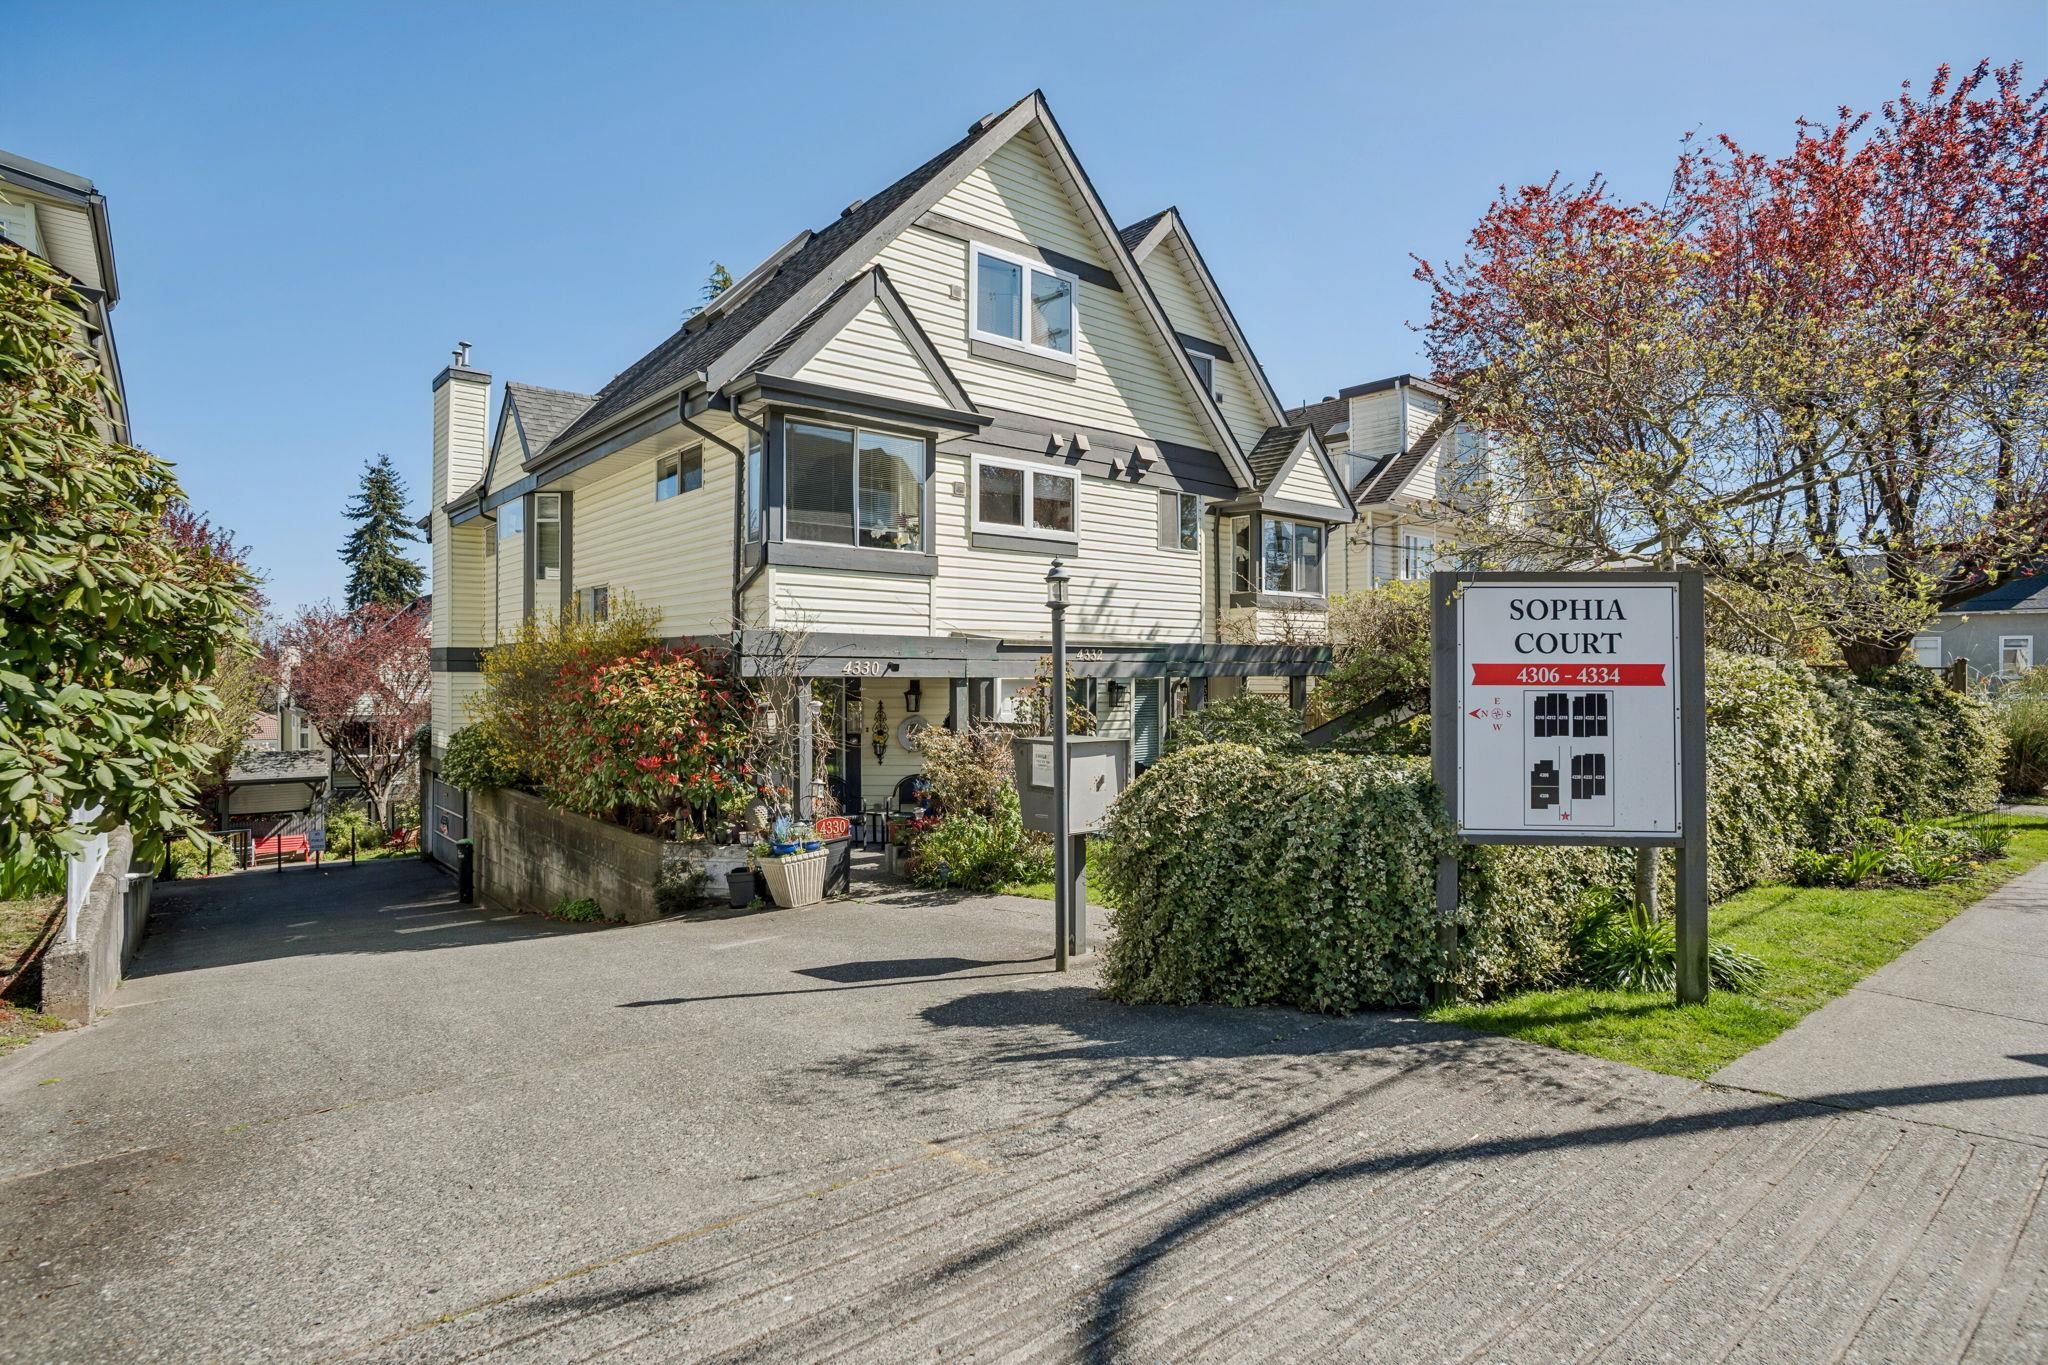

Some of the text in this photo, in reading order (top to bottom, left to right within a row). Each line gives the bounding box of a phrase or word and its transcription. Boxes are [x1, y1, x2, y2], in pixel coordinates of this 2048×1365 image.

[1509, 598, 1627, 621] SOPHIA
[1514, 632, 1622, 654] COURT
[1076, 649, 1103, 661] 4332
[842, 660, 879, 675] 4330
[1516, 666, 1560, 683] 4306
[1576, 667, 1620, 683] 4334
[1494, 697, 1501, 705] E
[1481, 710, 1489, 718] N
[1506, 710, 1512, 718] S
[1492, 723, 1503, 732] W
[820, 820, 846, 834] 4330
